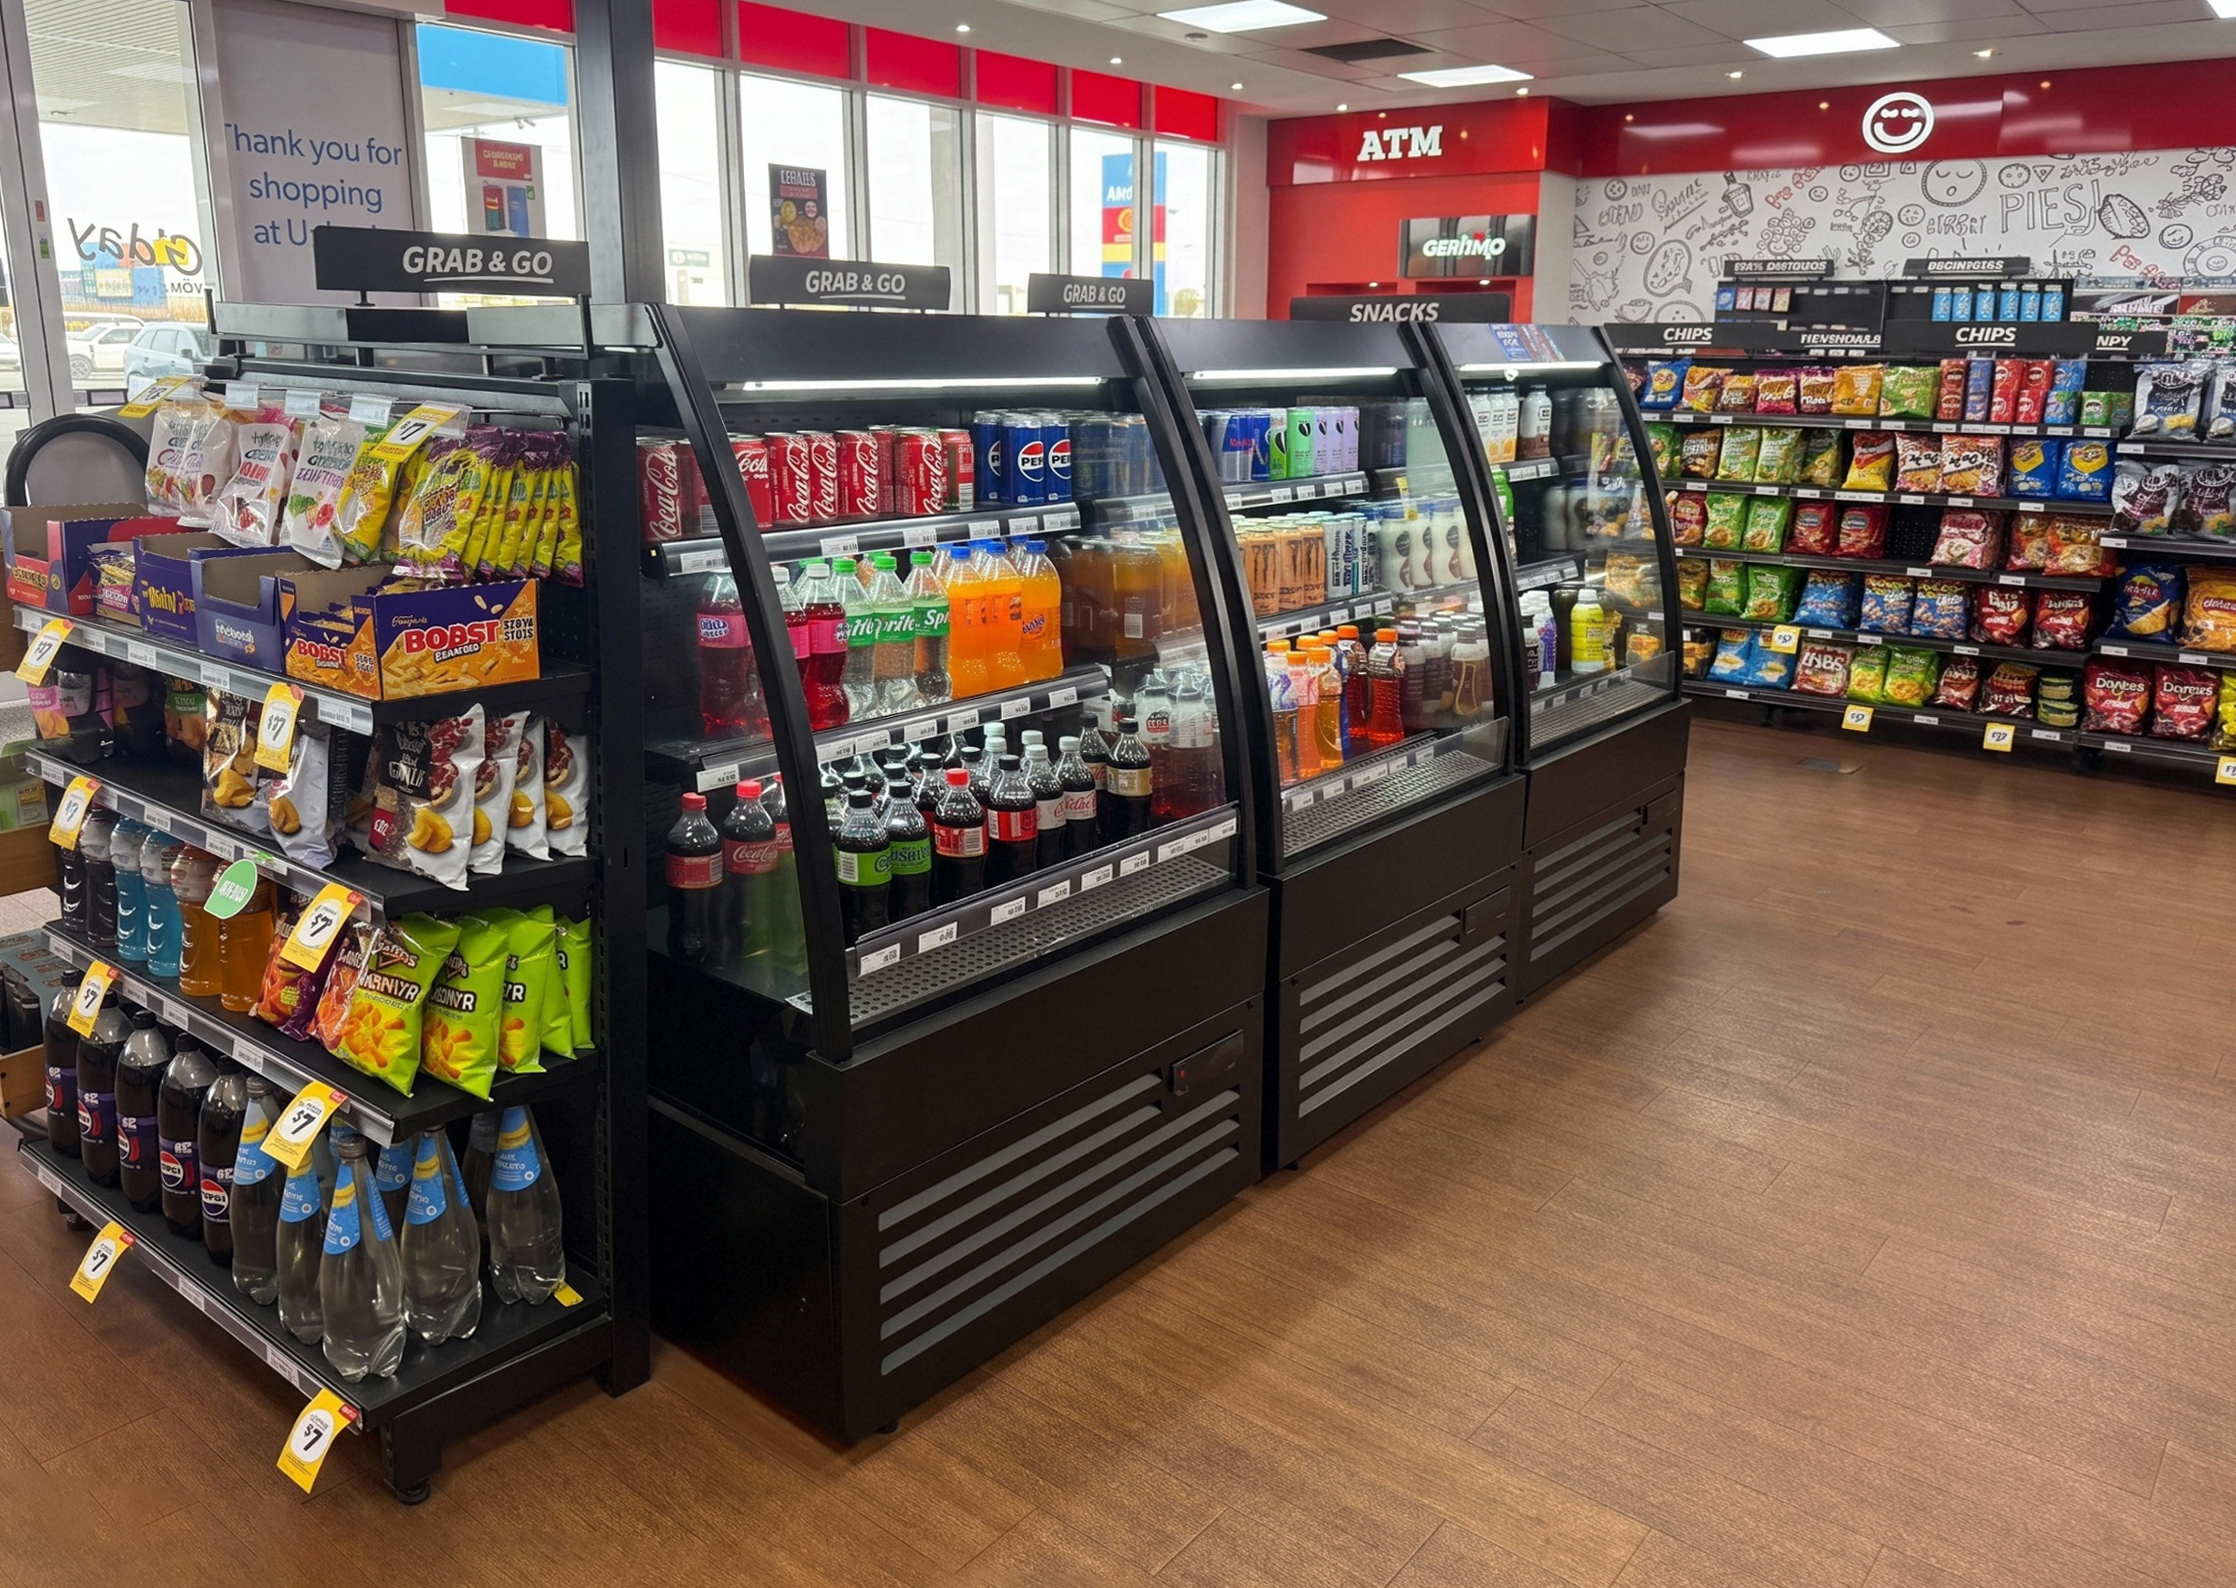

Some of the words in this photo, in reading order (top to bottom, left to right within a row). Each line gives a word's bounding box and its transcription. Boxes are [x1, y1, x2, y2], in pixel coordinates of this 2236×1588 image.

[309, 138, 360, 165] you
[366, 138, 402, 165] for
[1356, 125, 1443, 162] ATM
[249, 172, 382, 213] shopping
[253, 219, 281, 245] at
[402, 246, 483, 274] GRAB
[488, 252, 506, 273] &
[512, 250, 553, 276] GO
[805, 270, 858, 294] GRAB
[861, 273, 873, 292] &
[876, 271, 906, 295] GO
[1063, 283, 1097, 303] GRAB
[1098, 287, 1106, 302] &
[1108, 286, 1126, 304] GO
[1350, 302, 1440, 322] SNACKS
[1663, 327, 1713, 342] CHIPS
[1955, 326, 2017, 342] CHIPS
[291, 1110, 317, 1136] $7
[303, 1424, 324, 1453] $7
